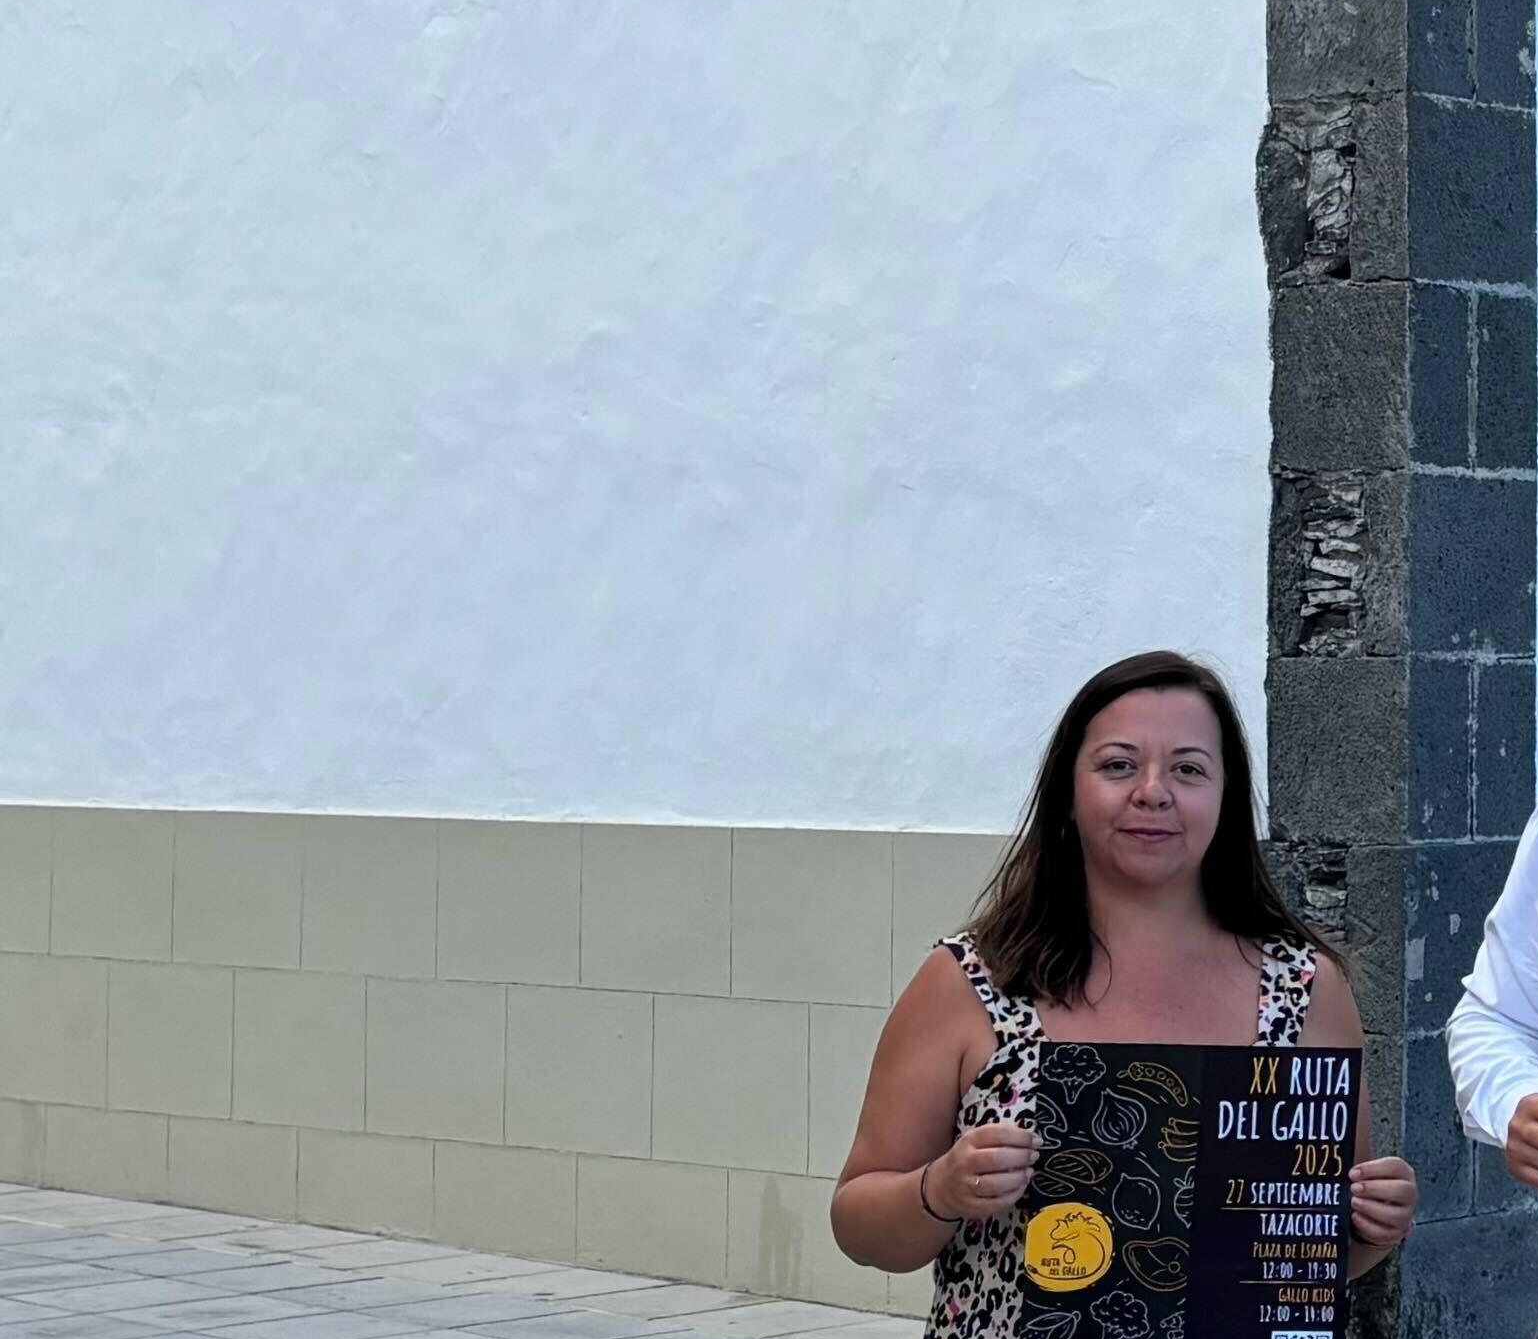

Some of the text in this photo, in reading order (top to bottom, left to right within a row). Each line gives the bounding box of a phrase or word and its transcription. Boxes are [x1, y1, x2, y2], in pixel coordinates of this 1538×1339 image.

[1250, 1057, 1349, 1096] XX RUTA
[1218, 1101, 1348, 1142] DEL GALLO
[1292, 1144, 1342, 1177] 2025
[1226, 1179, 1341, 1206] 27 SEPTIEMBRE
[1260, 1214, 1339, 1236] TAZACORTE
[1263, 1262, 1293, 1279] 12:00
[1308, 1262, 1337, 1279] 19:30
[1278, 1288, 1335, 1303] GALLO KIDS
